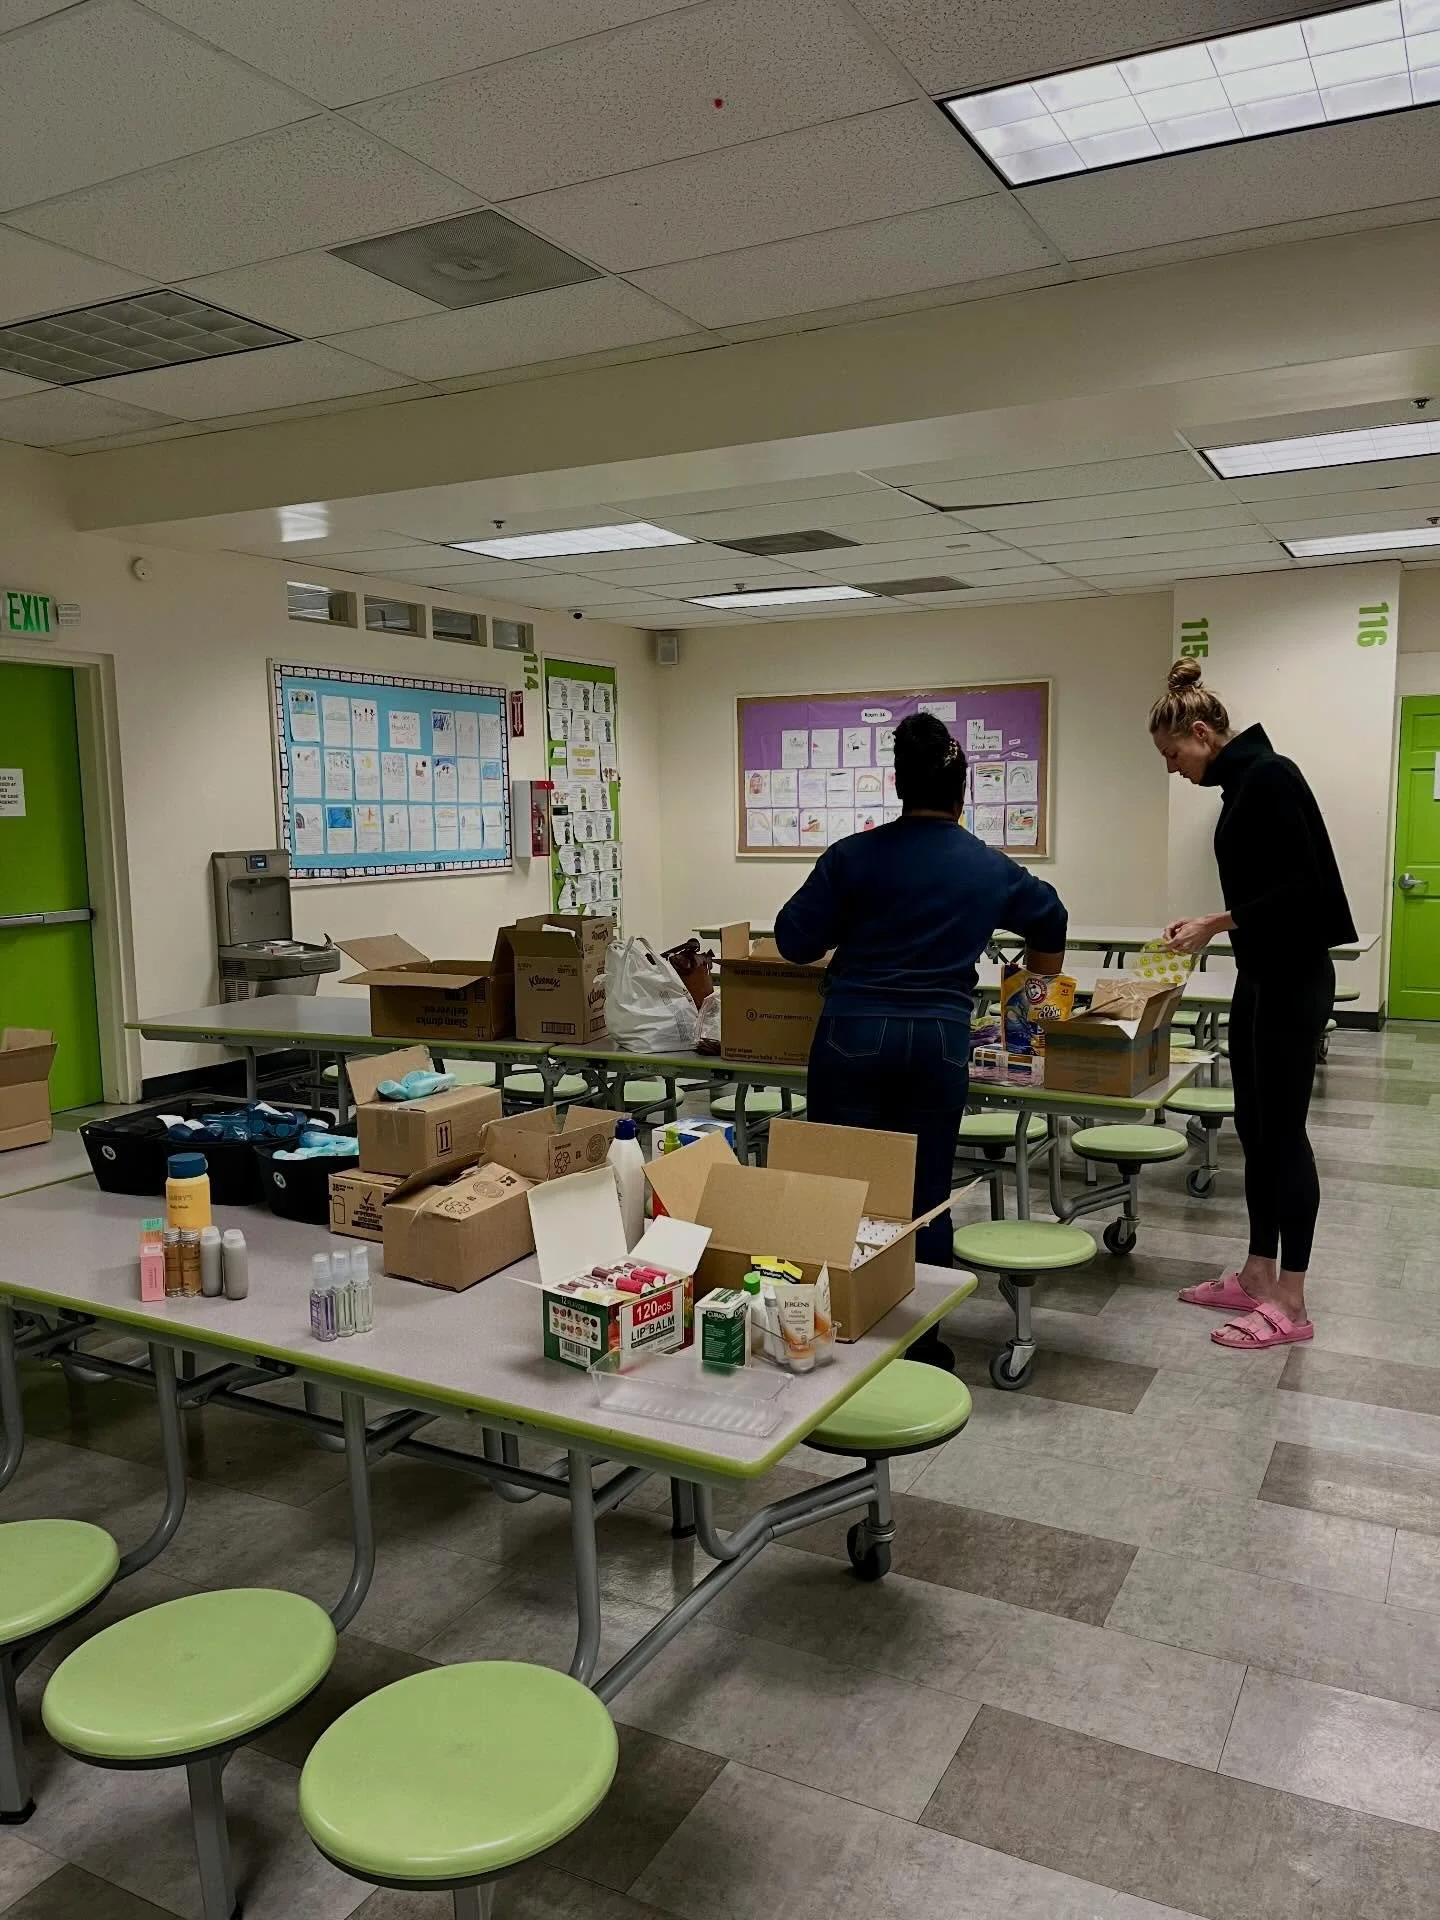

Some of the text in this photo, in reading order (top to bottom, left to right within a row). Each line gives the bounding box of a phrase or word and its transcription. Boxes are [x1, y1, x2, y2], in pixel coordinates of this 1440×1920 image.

[7, 592, 50, 632] EXIT
[1356, 602, 1389, 648] 116
[1181, 617, 1209, 658] 115
[523, 654, 539, 690] 114
[528, 975, 560, 988] Kleenex
[561, 1296, 567, 1305] 12
[784, 1300, 809, 1309] JERGENS
[631, 1327, 646, 1342] LIP
[649, 1315, 675, 1335] BALM
